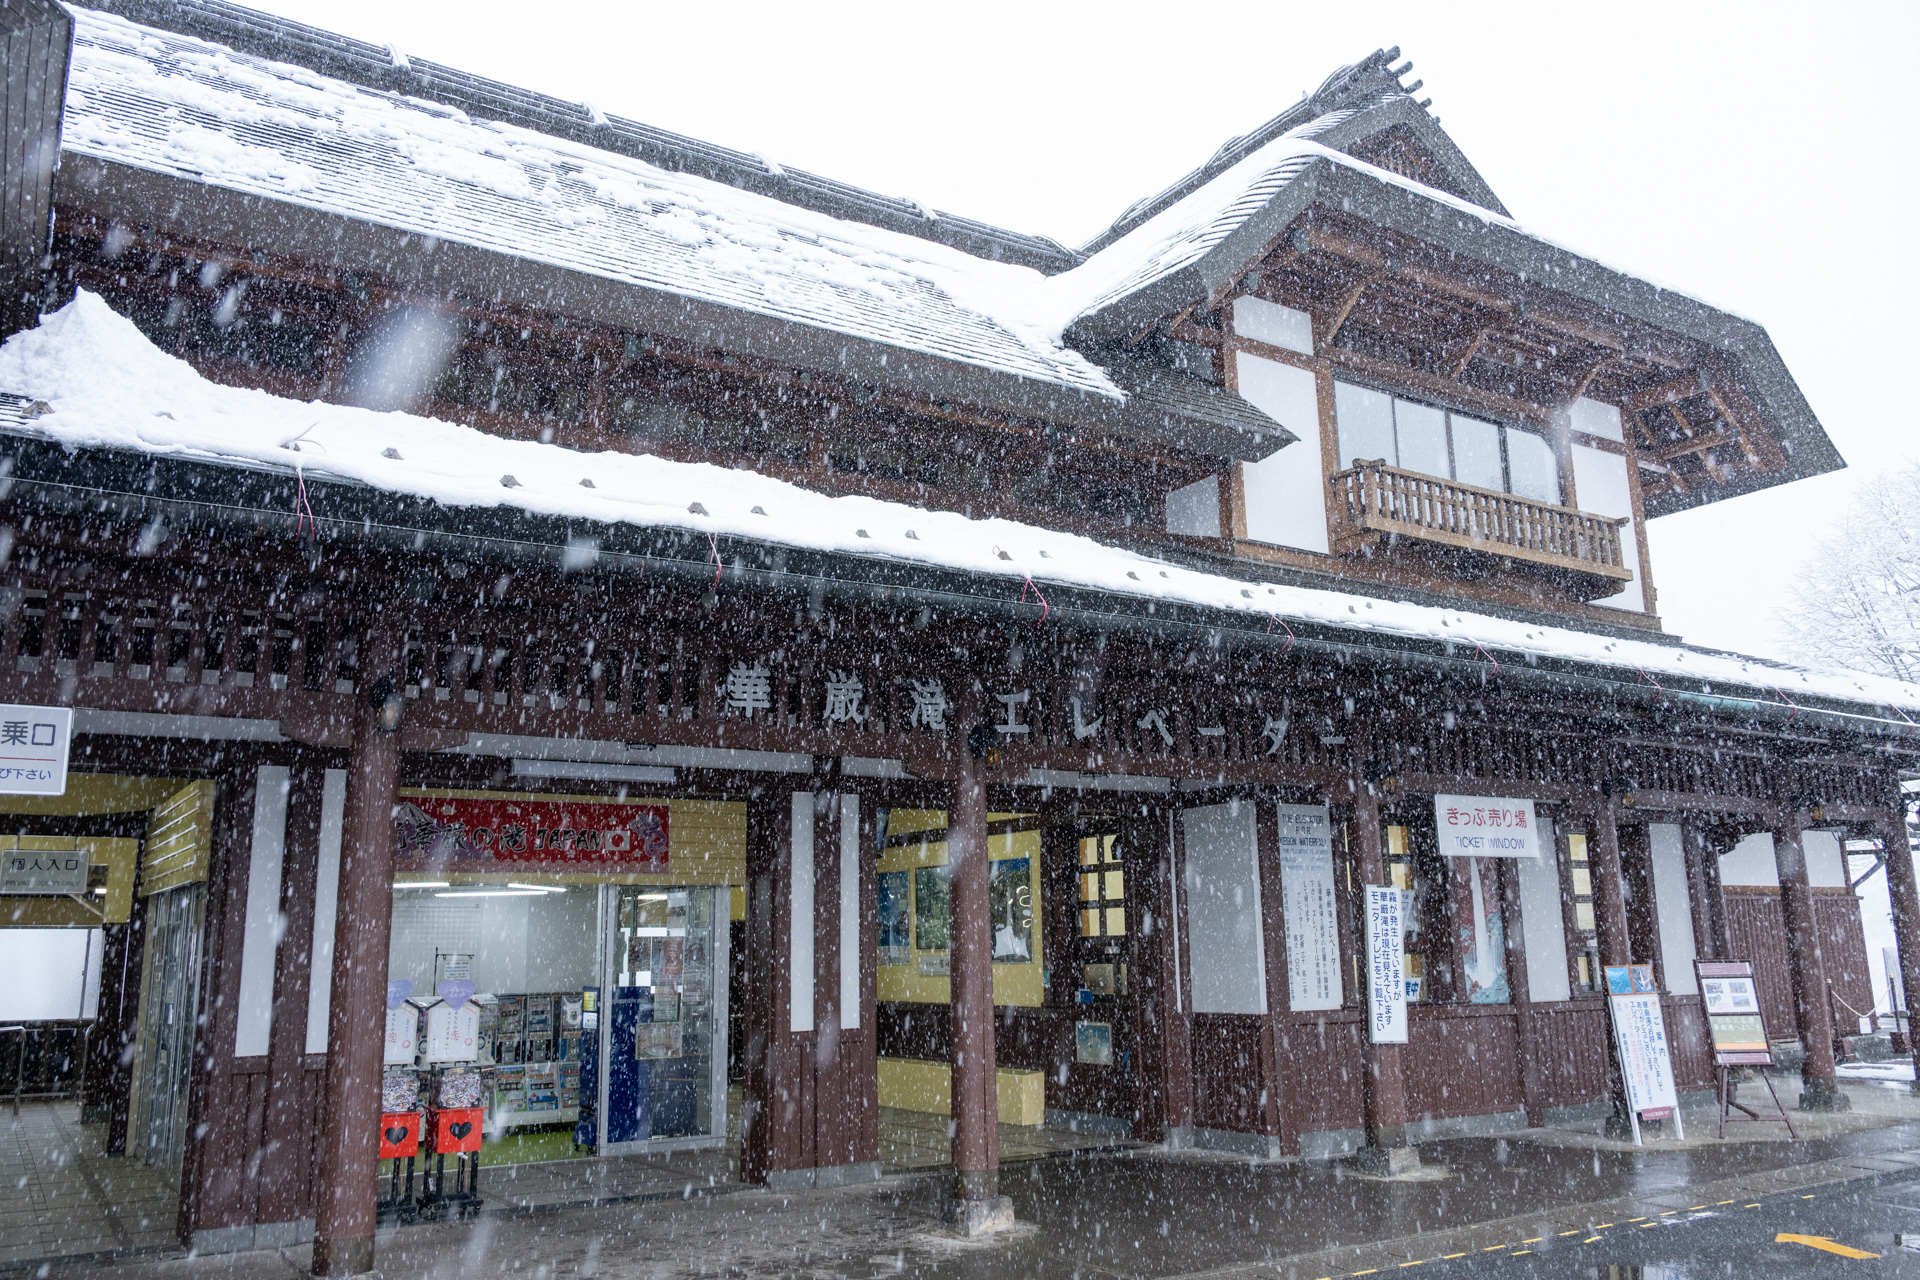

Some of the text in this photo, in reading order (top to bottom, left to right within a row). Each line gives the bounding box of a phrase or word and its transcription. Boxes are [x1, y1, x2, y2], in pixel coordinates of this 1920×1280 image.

[725, 661, 1346, 753] 華厳滝エレベーター
[1, 721, 56, 746] 乗口
[1282, 814, 1292, 824] THE
[1447, 807, 1527, 828] きっぷ売り場
[536, 827, 602, 850] JAPAN
[1279, 837, 1297, 846] KEGON
[1296, 826, 1311, 835] FOR
[1454, 836, 1525, 849] TICKET WINDOW
[12, 858, 78, 870] 個人入口
[1389, 891, 1402, 1001] 霧が発生していますが
[1371, 891, 1384, 1032] モニターテレビをご覧下さい
[1380, 891, 1392, 1026] 華厳滝は現在見えています
